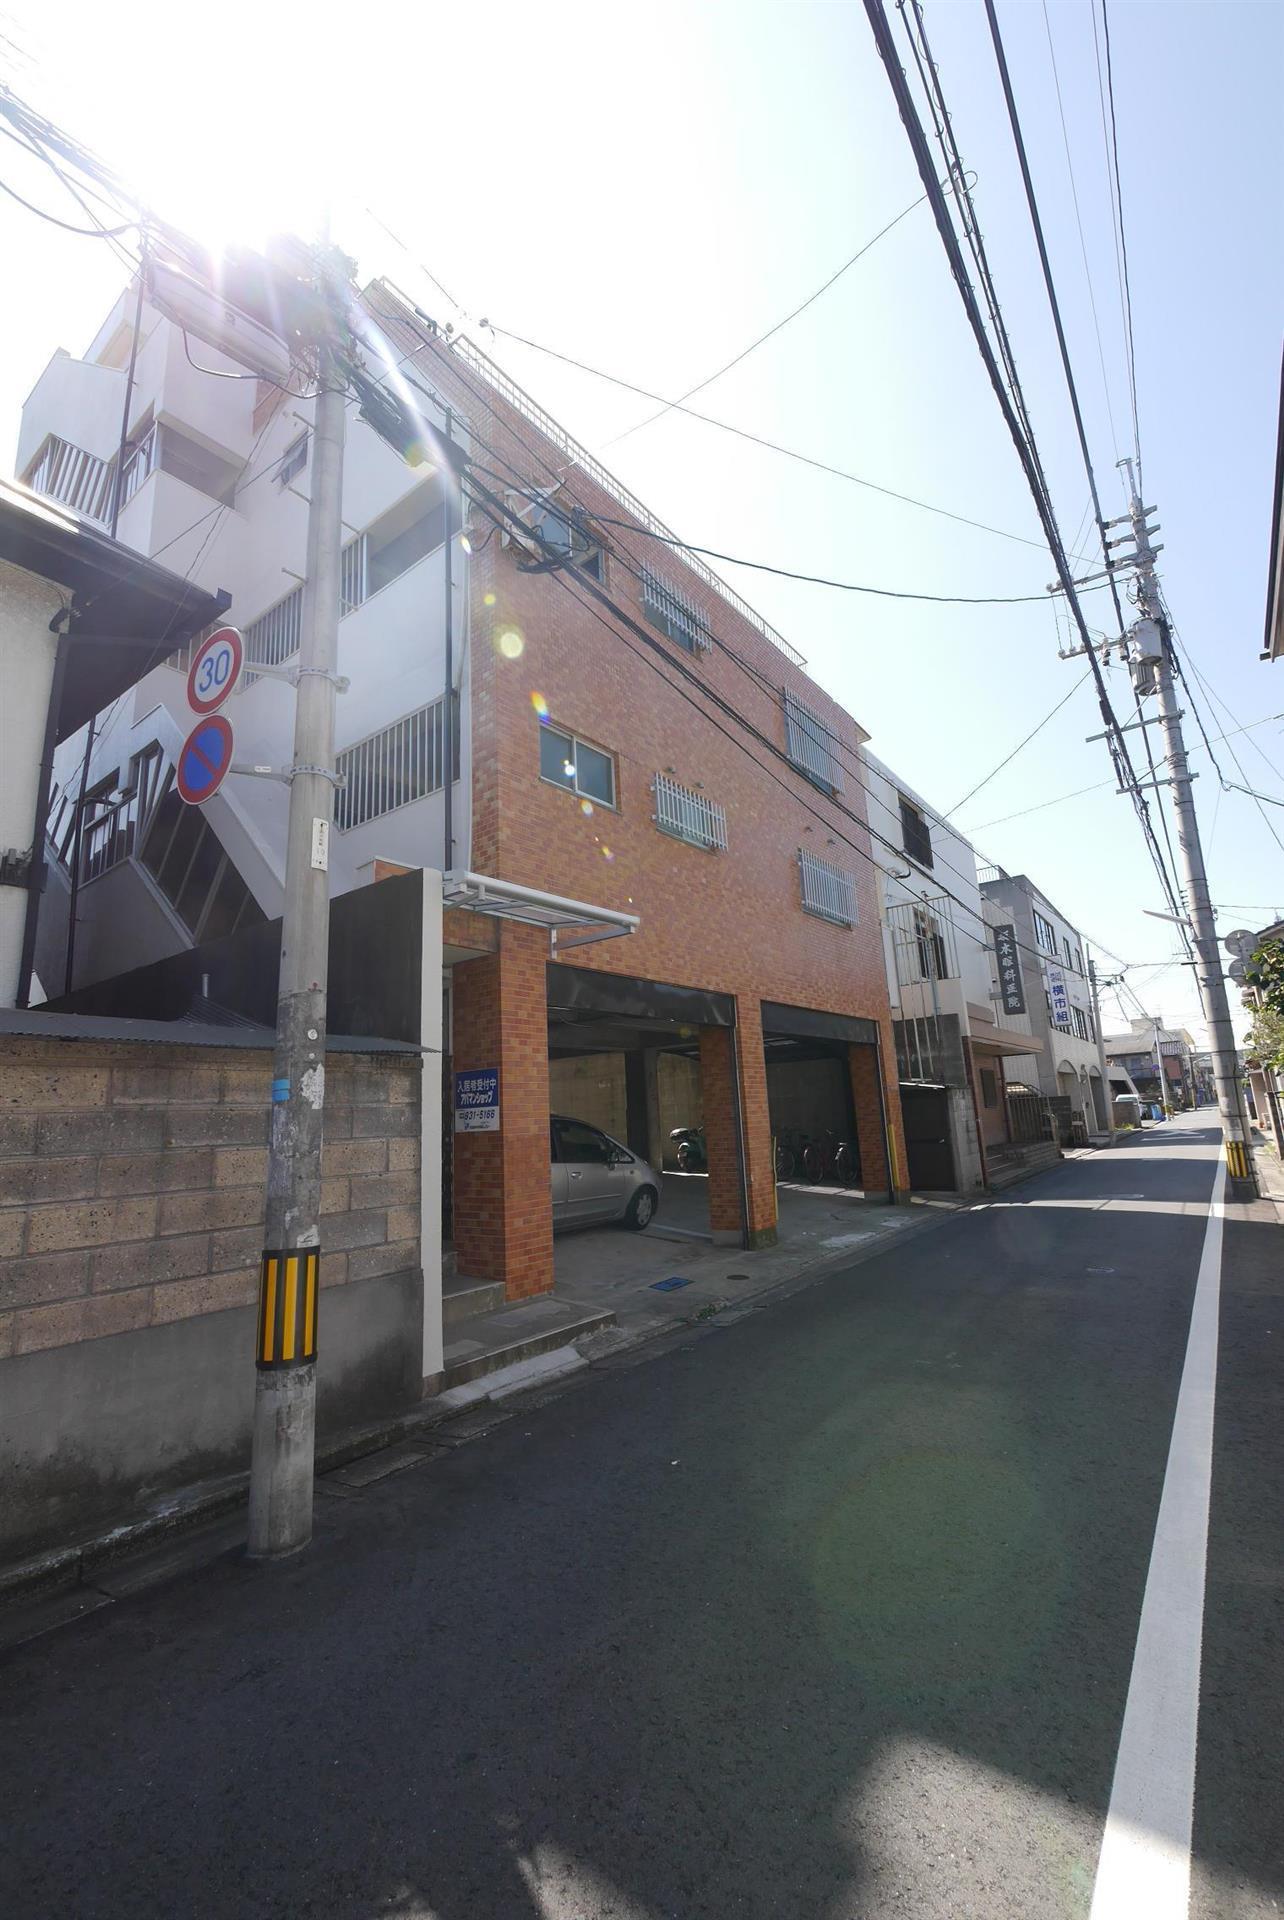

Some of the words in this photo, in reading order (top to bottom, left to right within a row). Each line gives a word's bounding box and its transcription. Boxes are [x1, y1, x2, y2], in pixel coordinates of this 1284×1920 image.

[199, 649, 230, 693] 30
[457, 1077, 497, 1093] 入居者受付中
[460, 1090, 494, 1105] アパマンショップ
